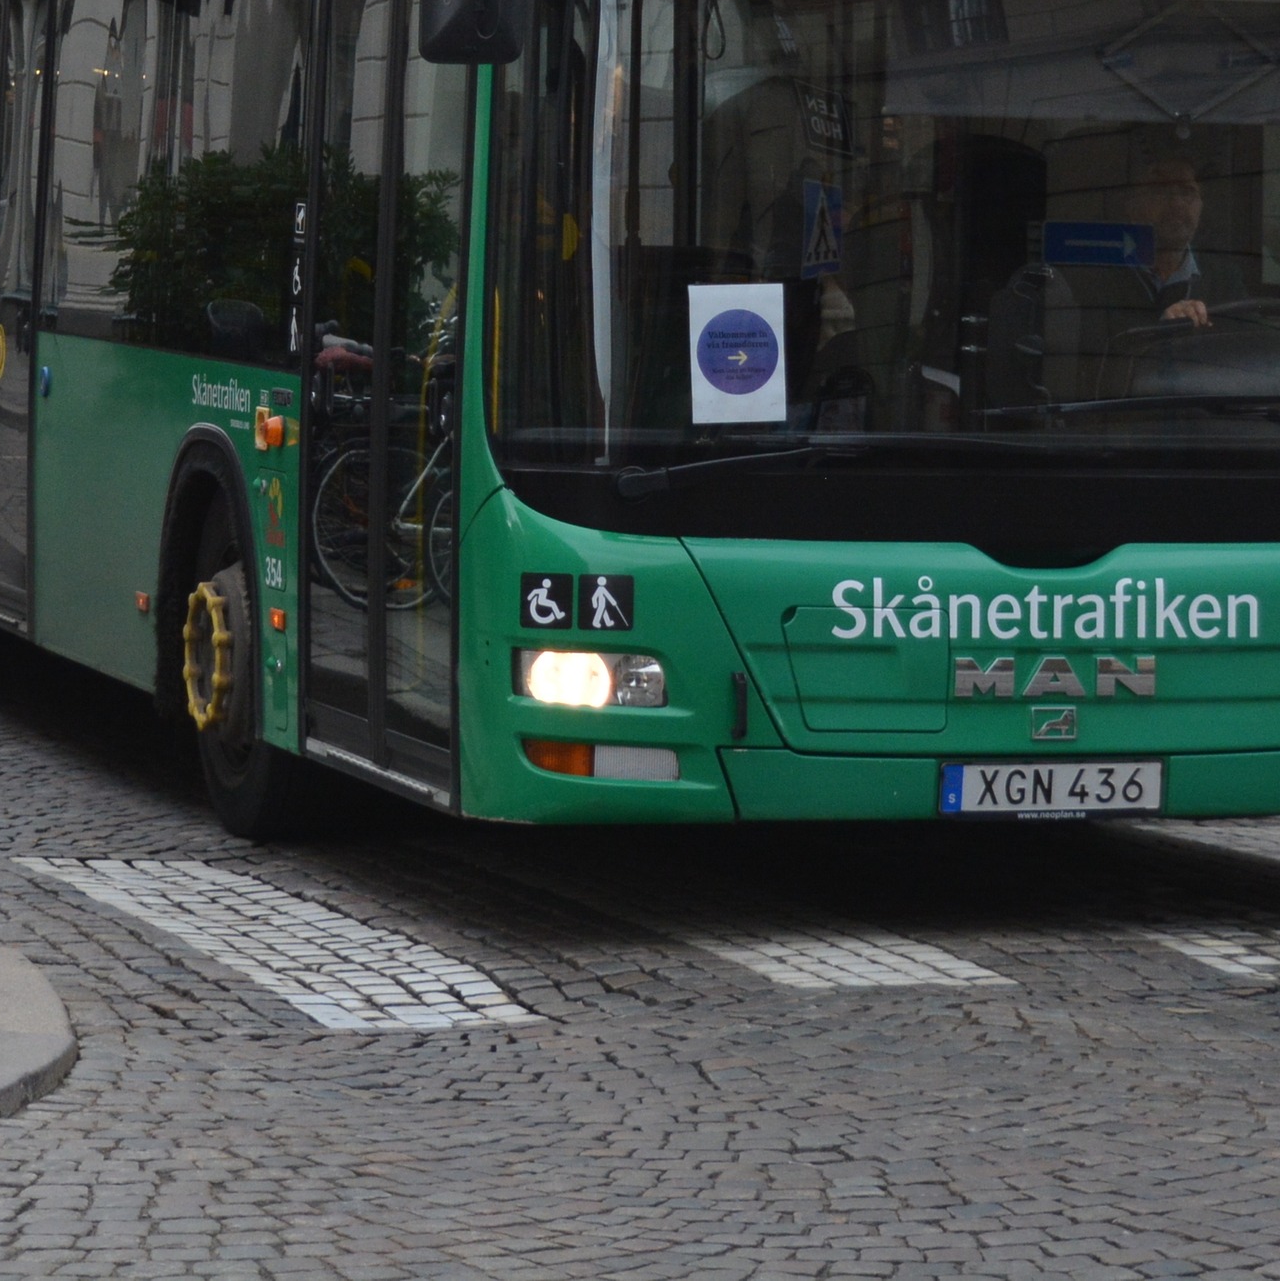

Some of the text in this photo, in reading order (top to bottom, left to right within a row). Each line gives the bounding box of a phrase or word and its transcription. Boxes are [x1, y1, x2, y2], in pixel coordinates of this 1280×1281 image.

[192, 373, 251, 413] Skånetrafiken
[265, 556, 282, 588] 354
[831, 575, 1260, 640] Skånetrafiken
[954, 655, 1156, 698] MAN
[948, 767, 1144, 806] S XGN 436
[1017, 809, 1087, 819] www.neoplan.se
